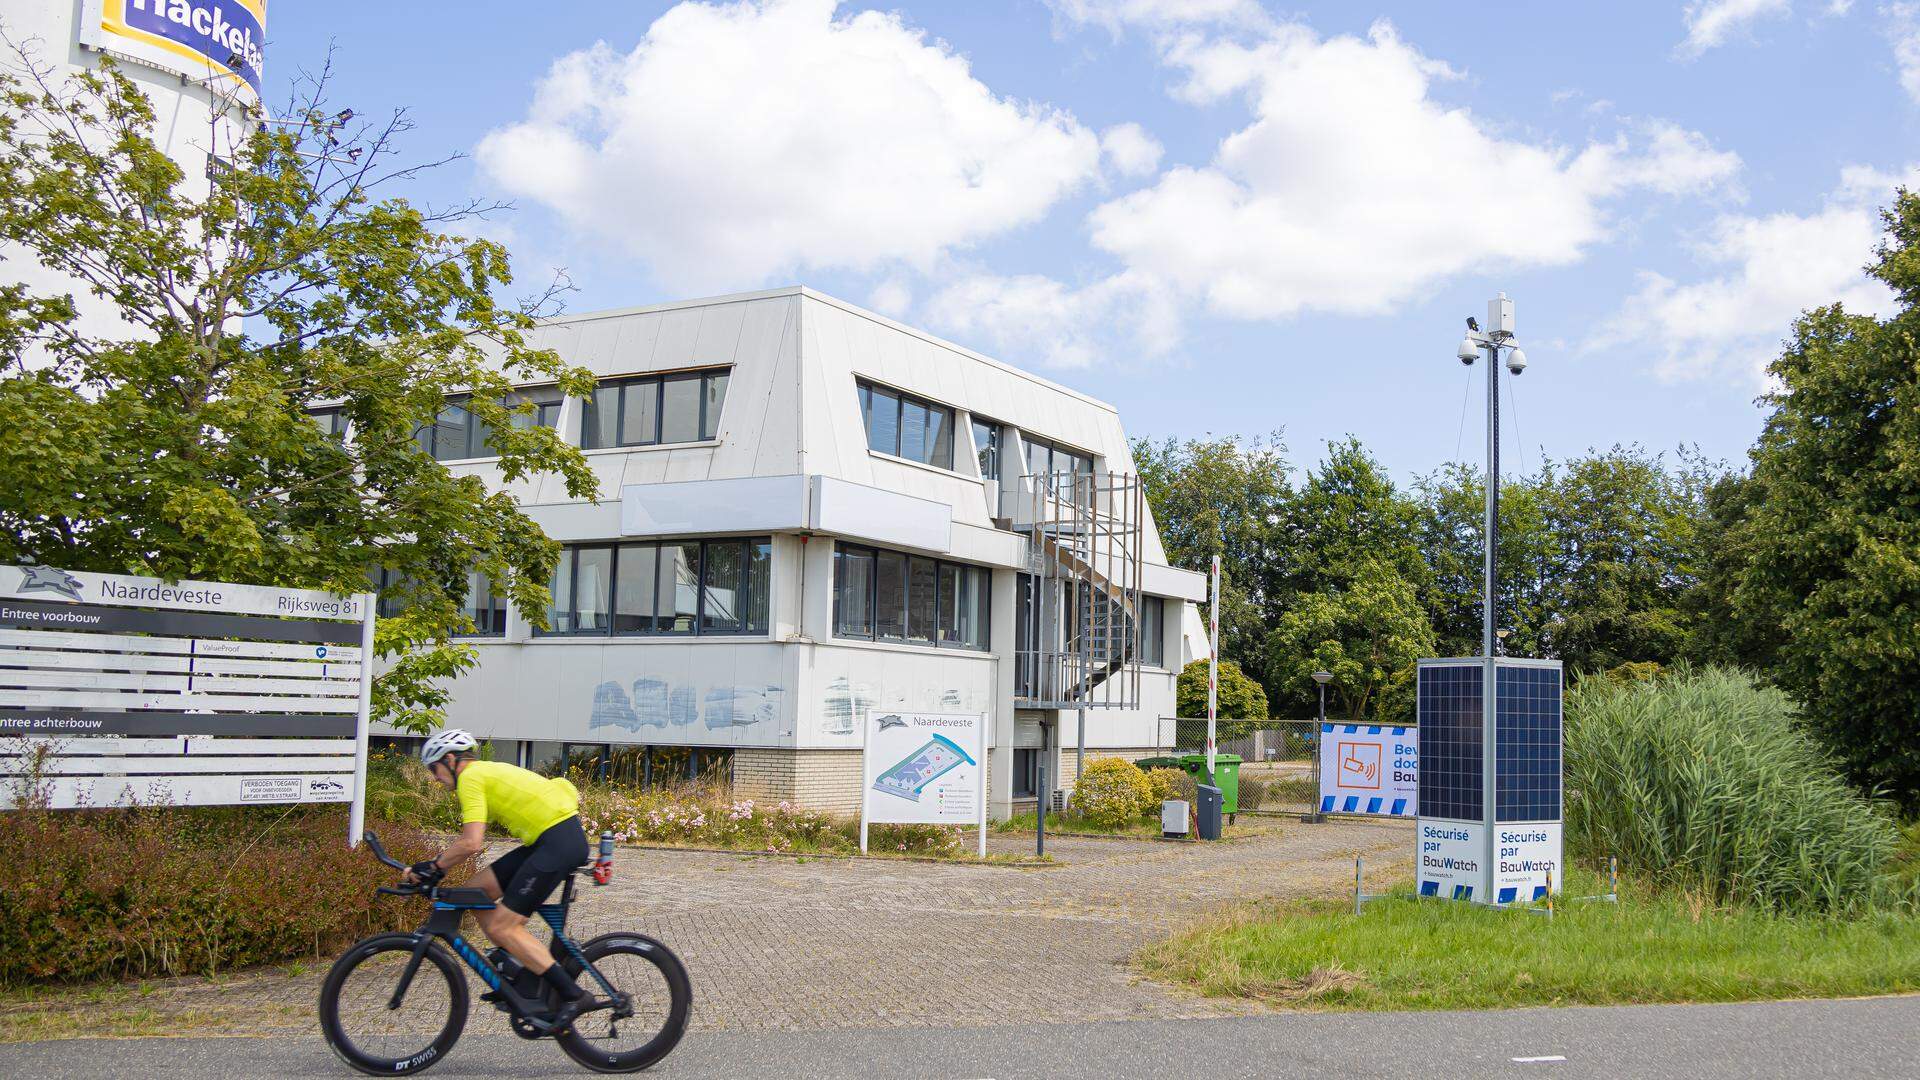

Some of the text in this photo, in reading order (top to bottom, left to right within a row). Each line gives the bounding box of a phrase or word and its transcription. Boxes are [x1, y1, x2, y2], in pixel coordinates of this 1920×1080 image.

[101, 580, 222, 604] Naardeveste
[278, 596, 358, 616] Rijksweg 81
[1, 608, 101, 624] Entree voorbouw
[202, 644, 241, 652] ValueProof
[33, 717, 102, 728] achterbouw
[913, 717, 973, 728] Naardeveste
[1423, 826, 1469, 841] Sécurisé
[1501, 830, 1547, 844] Sécurisé
[1423, 841, 1441, 852] par
[1501, 847, 1519, 860] par
[1423, 855, 1478, 872] BauWatch
[1500, 859, 1555, 873] BauWatch
[395, 1046, 437, 1071] DT SWISS
